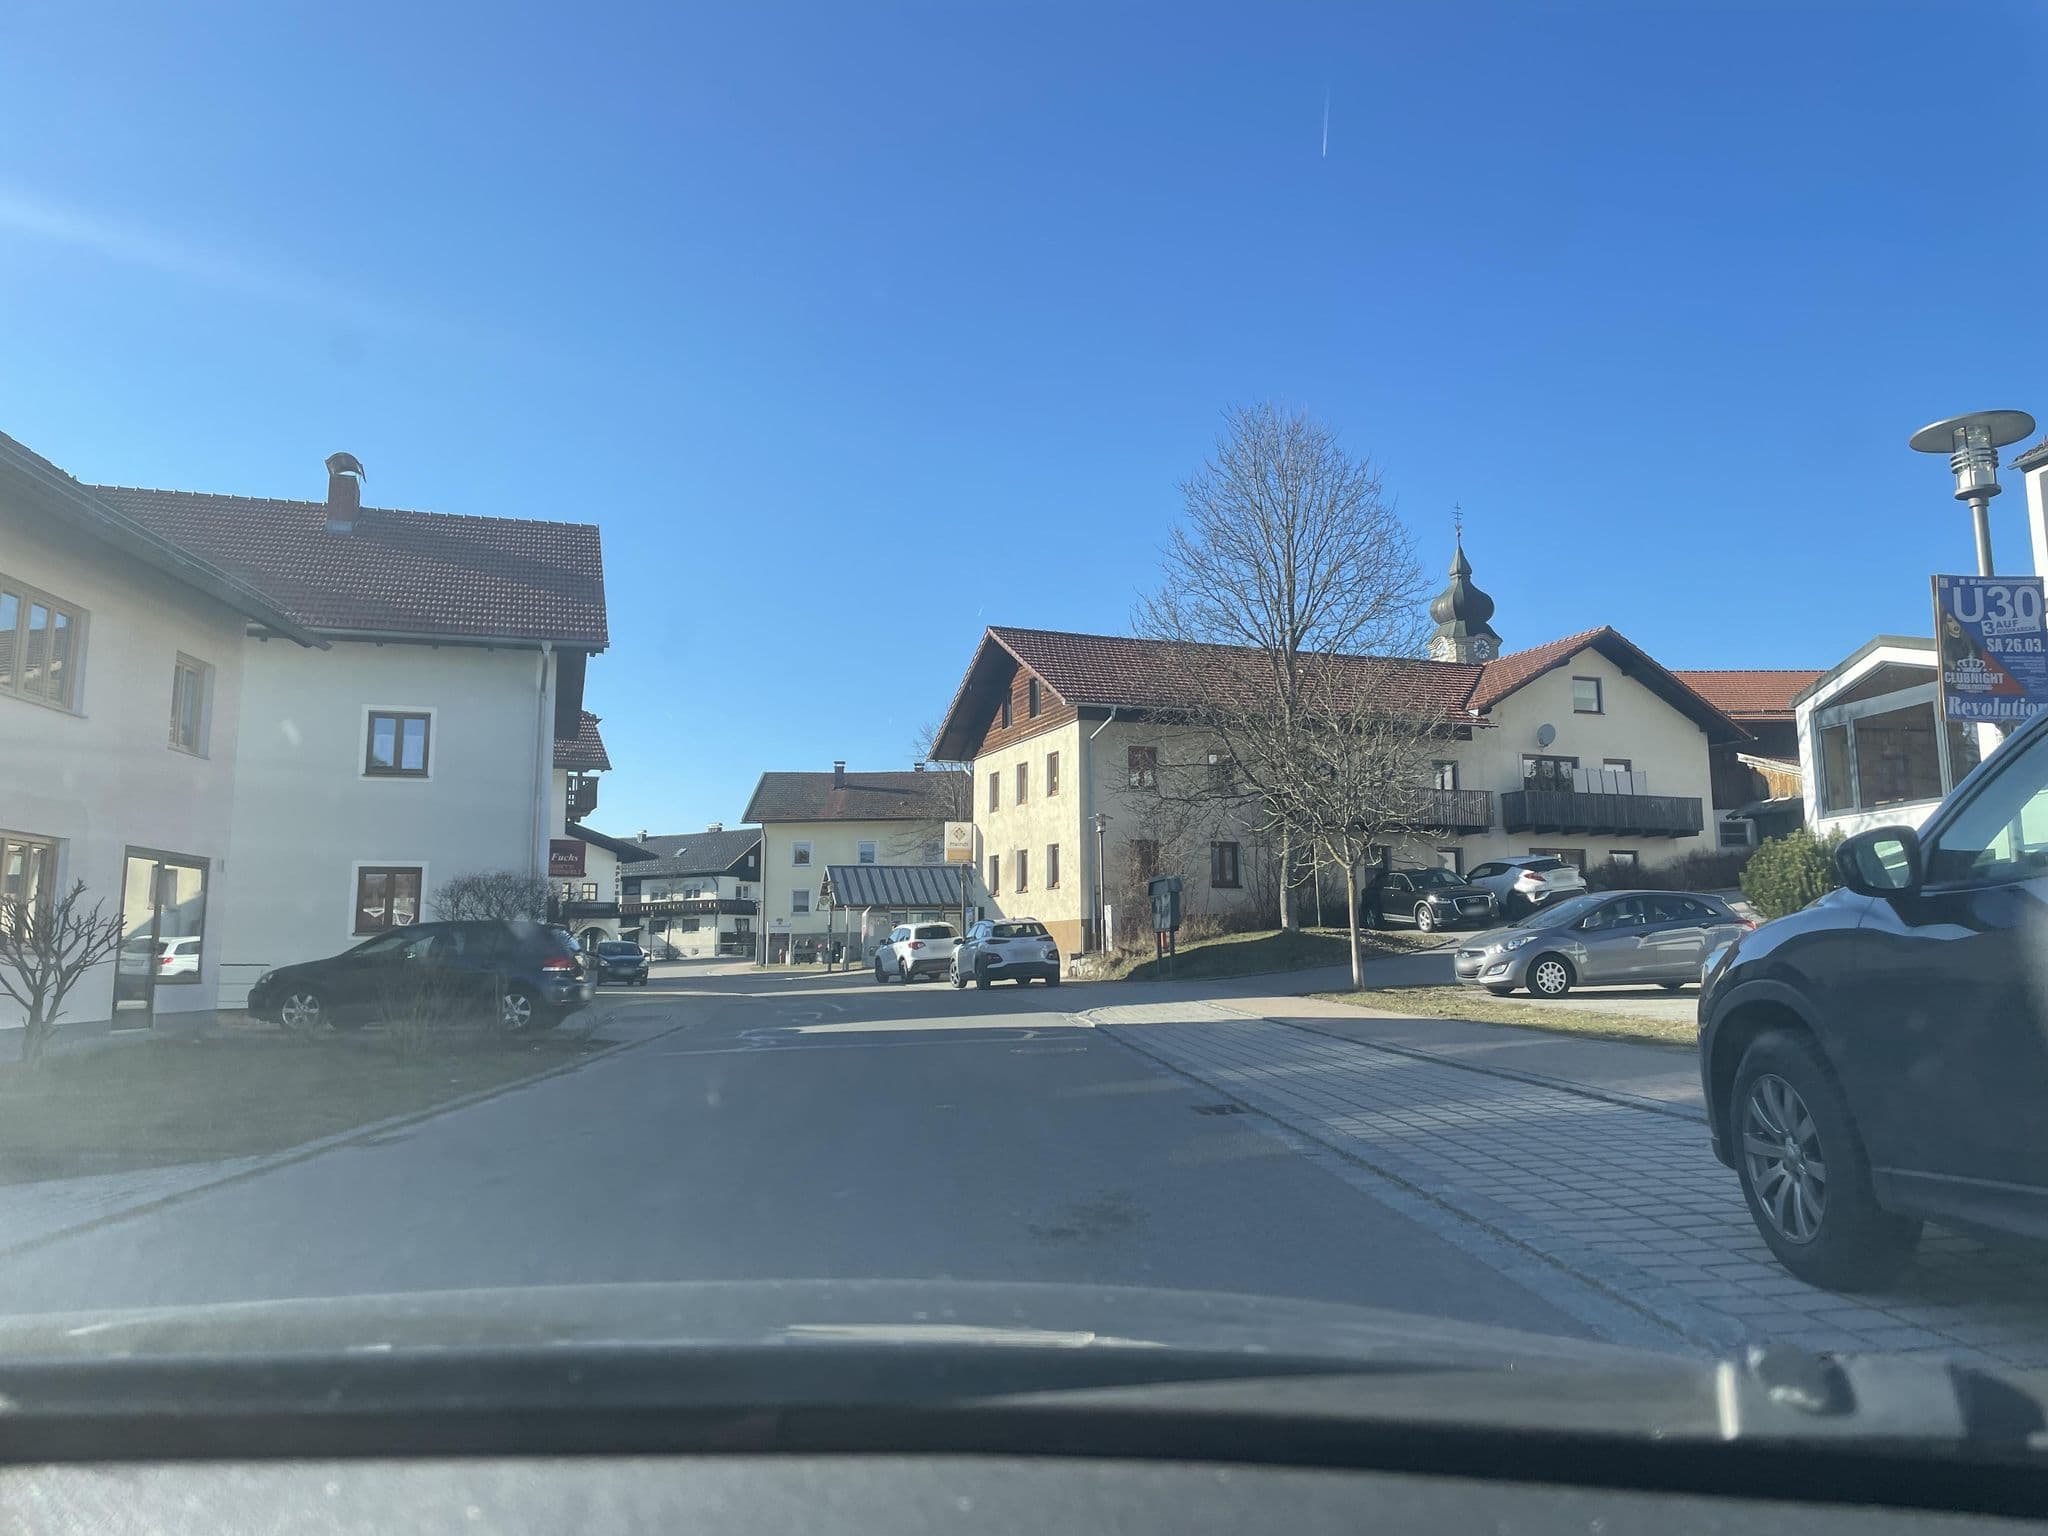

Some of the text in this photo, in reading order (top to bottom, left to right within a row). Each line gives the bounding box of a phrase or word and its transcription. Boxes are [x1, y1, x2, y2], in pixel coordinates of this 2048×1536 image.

[1953, 578, 2041, 622] Ü30
[1984, 622, 1995, 634] 3
[1997, 620, 2018, 628] AUF
[1986, 638, 2004, 652] SA
[1944, 671, 2004, 684] CLUBNIGHT
[551, 852, 578, 861] Fuchs
